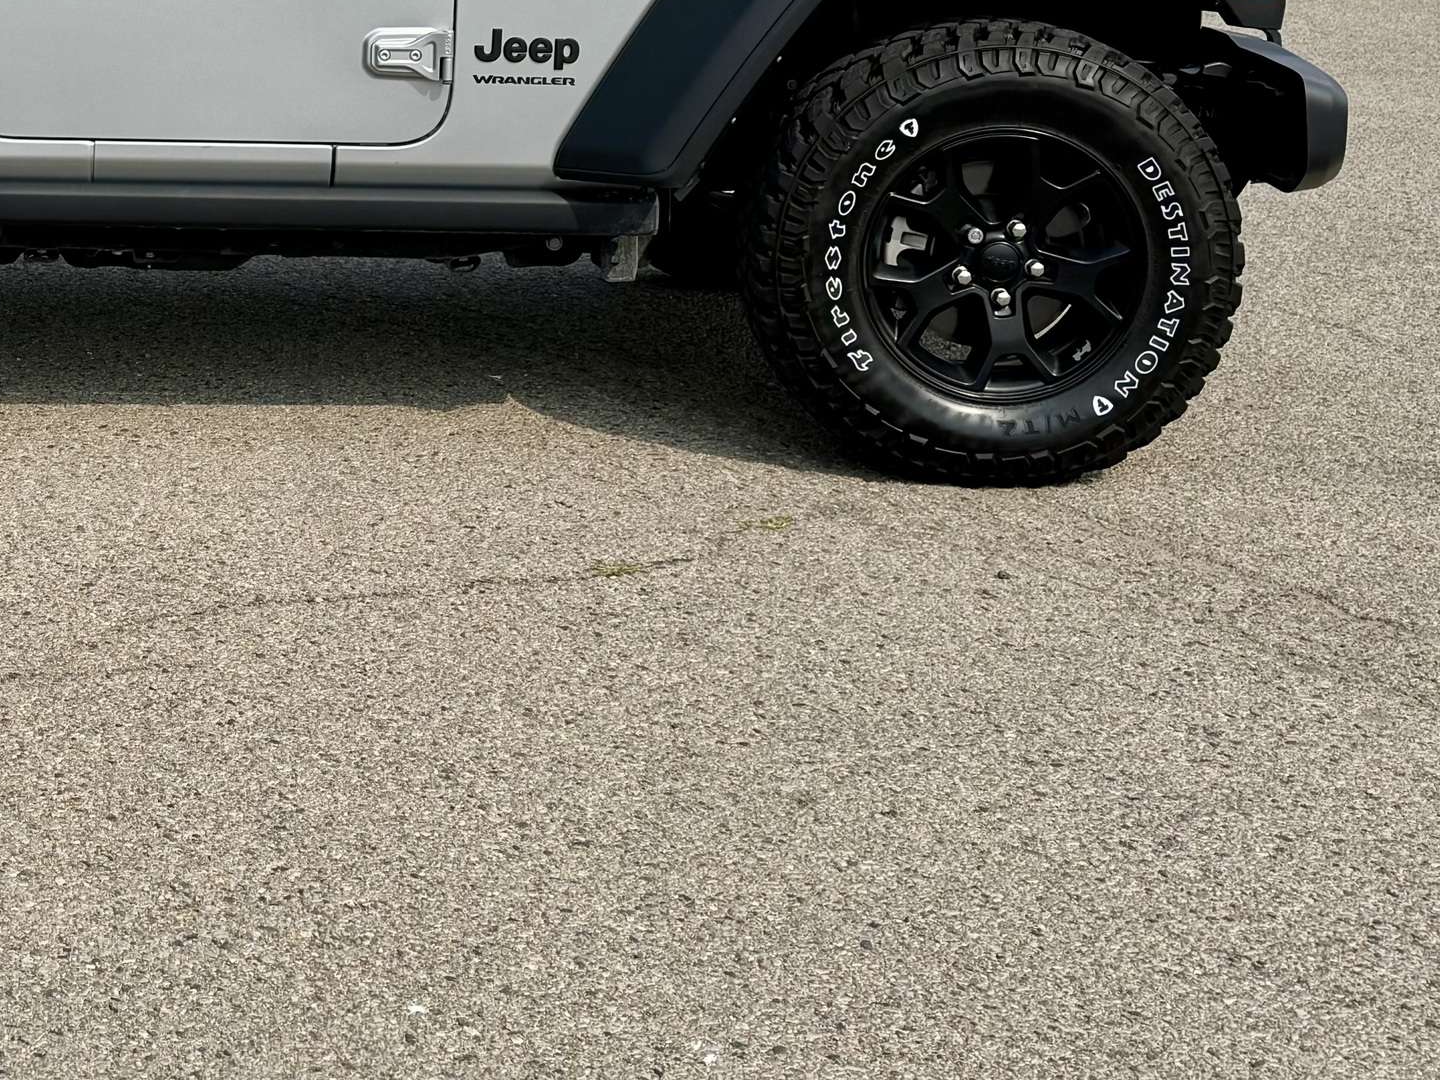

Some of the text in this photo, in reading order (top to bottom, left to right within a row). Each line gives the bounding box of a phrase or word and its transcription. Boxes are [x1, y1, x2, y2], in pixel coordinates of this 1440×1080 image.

[473, 74, 575, 86] WRANGLER
[474, 28, 580, 71] Jeep
[825, 139, 896, 371] Firestone
[1114, 157, 1191, 398] DESTINATION
